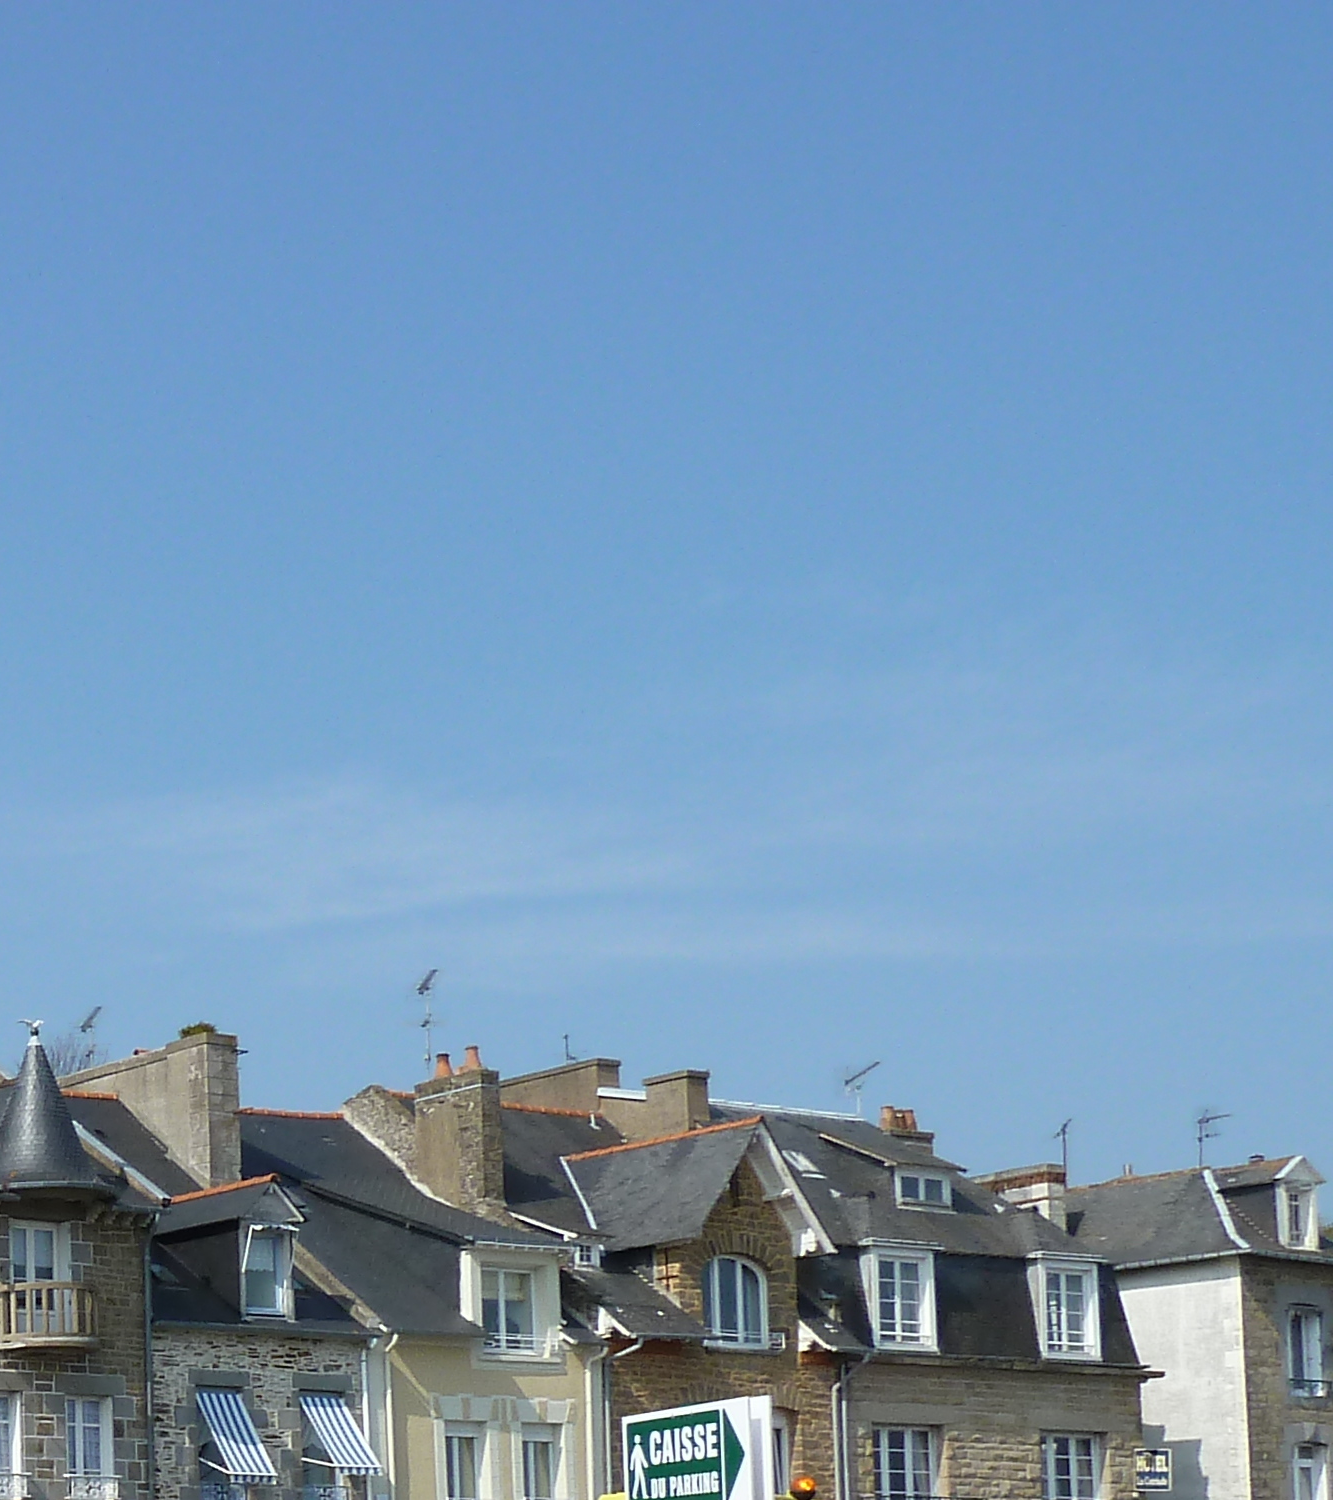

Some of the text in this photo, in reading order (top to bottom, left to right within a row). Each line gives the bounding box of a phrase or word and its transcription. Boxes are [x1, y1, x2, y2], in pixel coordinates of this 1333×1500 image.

[649, 1422, 719, 1466] CAISSE
[650, 1470, 720, 1499] DU PARKING
